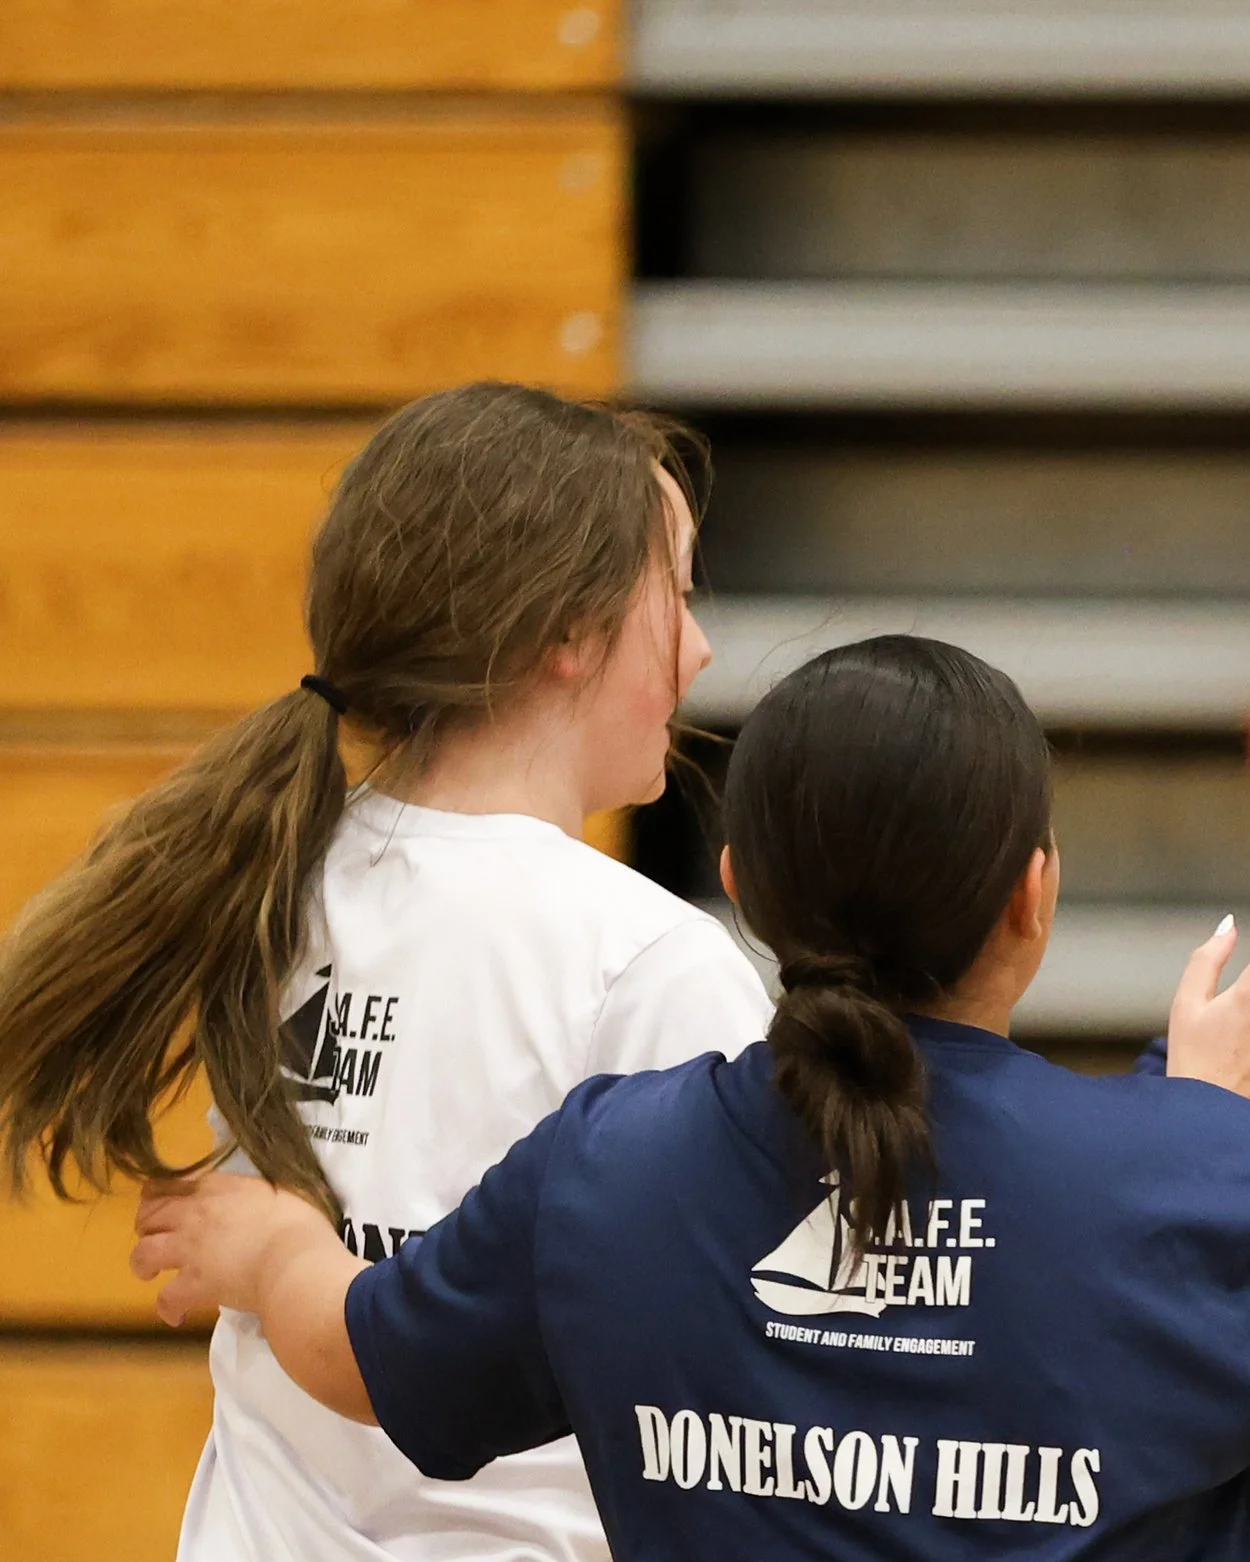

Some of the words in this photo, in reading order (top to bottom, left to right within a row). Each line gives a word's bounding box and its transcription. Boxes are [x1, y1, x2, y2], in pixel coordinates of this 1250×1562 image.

[863, 1253, 973, 1306] TEAM
[765, 1321, 822, 1345] STUDENT
[820, 1331, 847, 1347] AND
[847, 1333, 893, 1351] FAMILY
[893, 1337, 976, 1356] ENGAGEMENT
[634, 1405, 919, 1514] DONELSON
[932, 1439, 1101, 1528] HILLS
